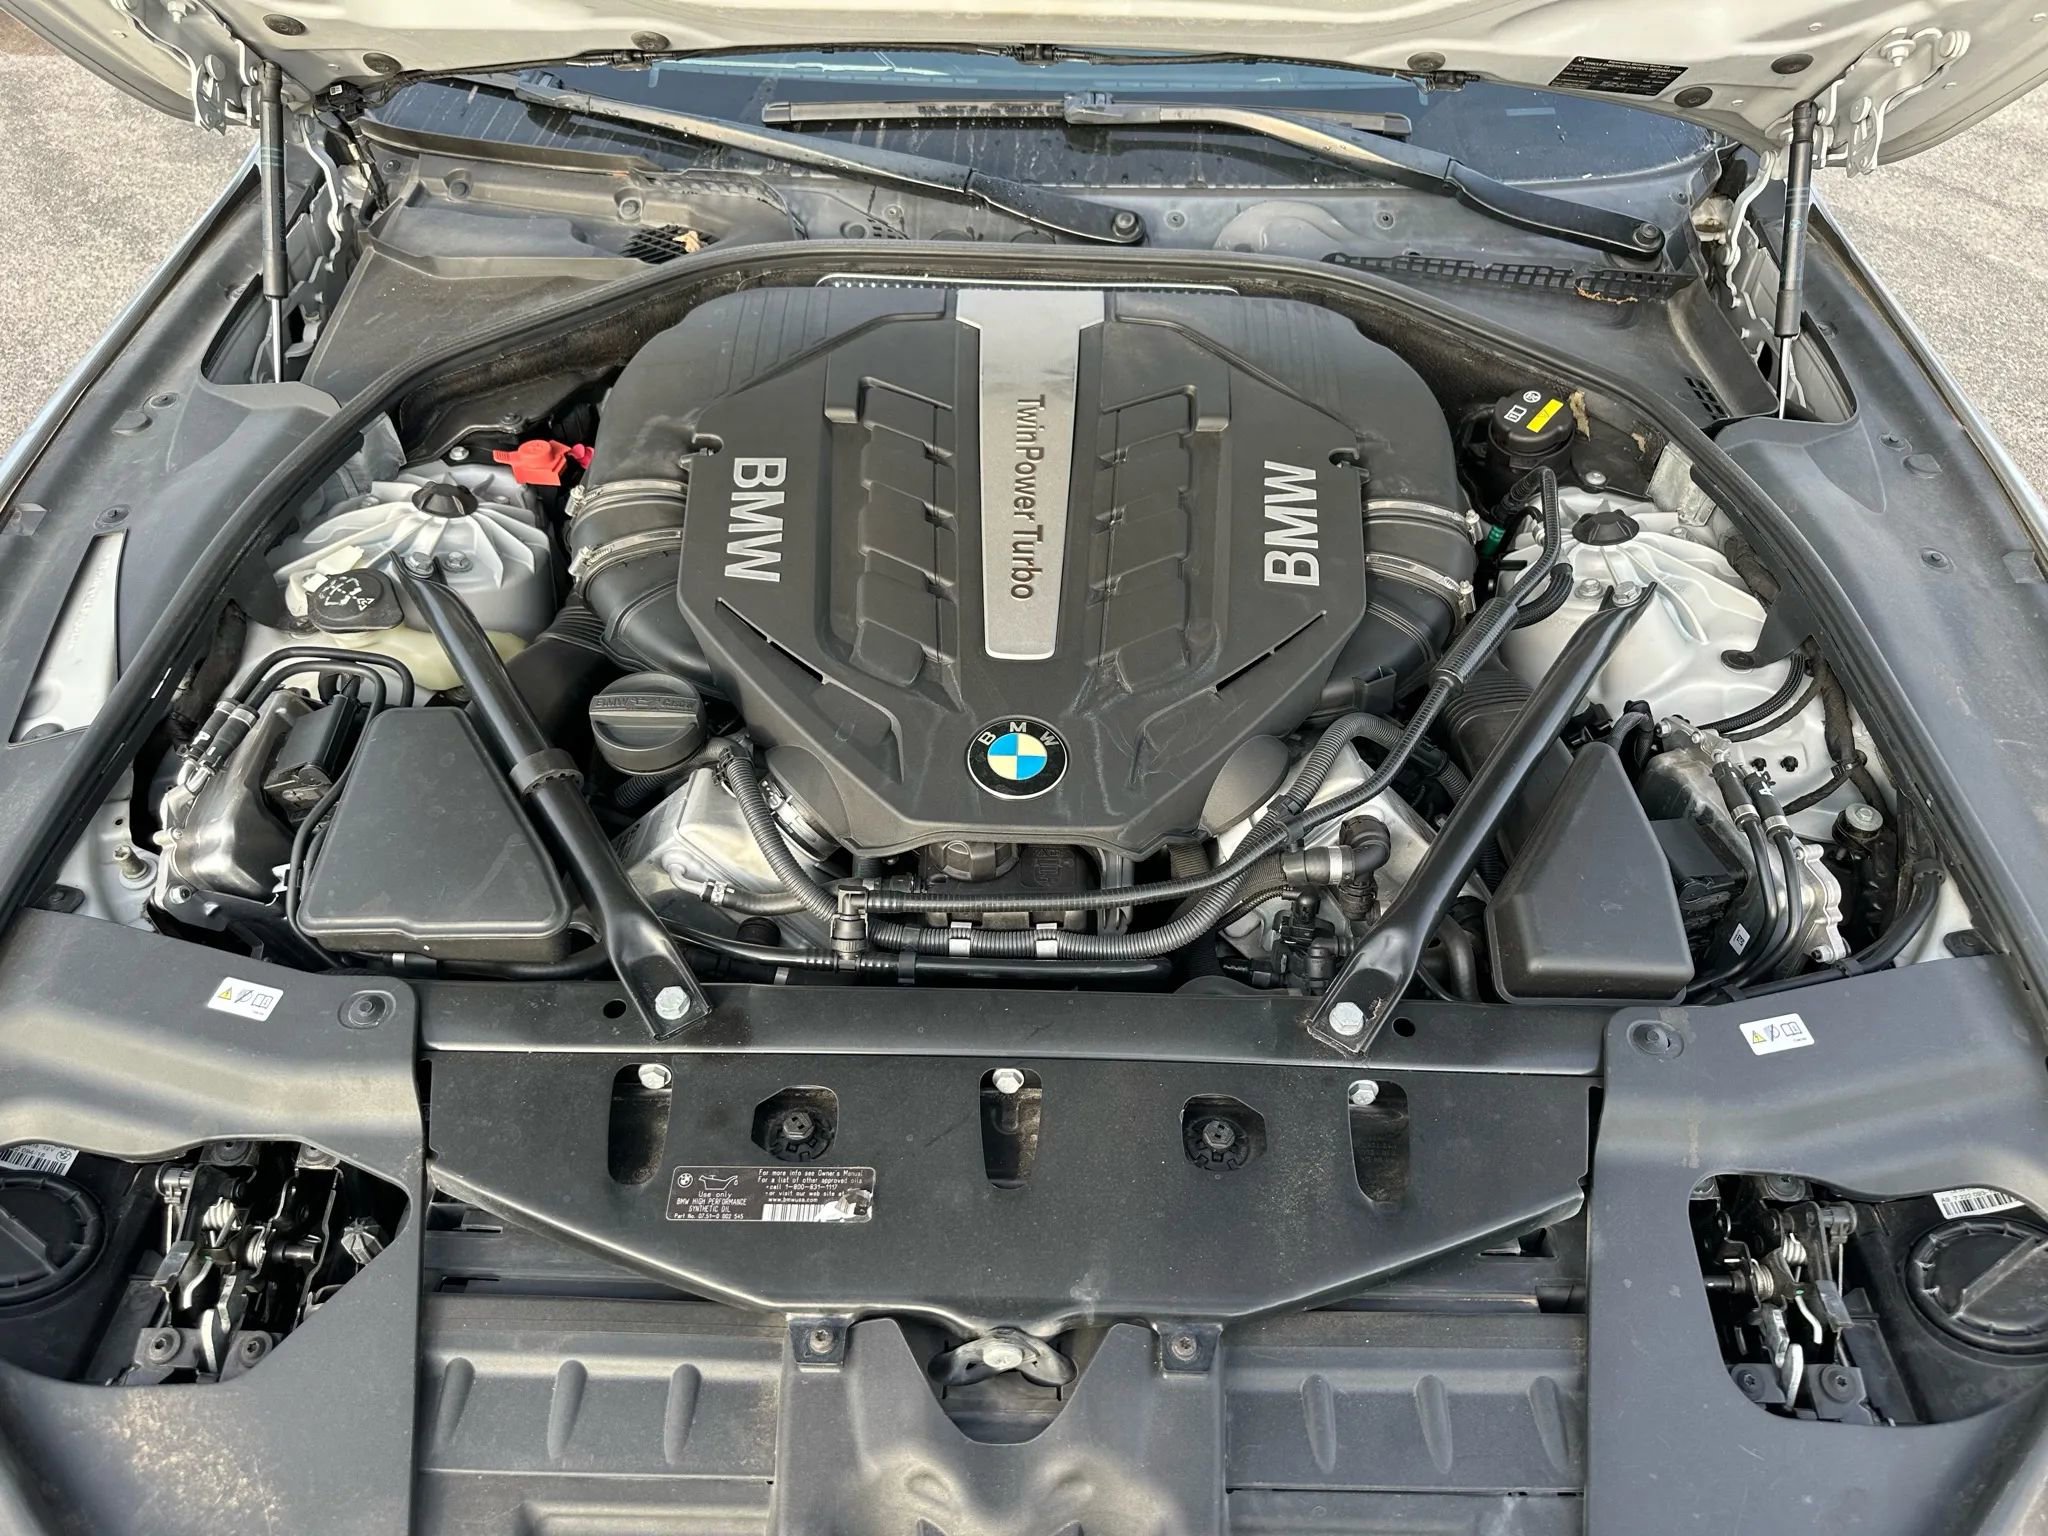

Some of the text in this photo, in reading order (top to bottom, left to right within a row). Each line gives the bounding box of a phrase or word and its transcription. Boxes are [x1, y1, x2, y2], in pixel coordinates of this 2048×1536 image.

[1011, 394, 1045, 600] TwinPower Turbo
[724, 457, 787, 583] BMW
[1264, 460, 1320, 586] BMW
[977, 721, 1059, 746] BMW
[818, 1169, 840, 1177] Owner's
[802, 1176, 818, 1184] other
[715, 1191, 733, 1200] only
[708, 1198, 747, 1206] PERFORMANCE
[688, 1205, 731, 1213] SYNTHETIC OIL
